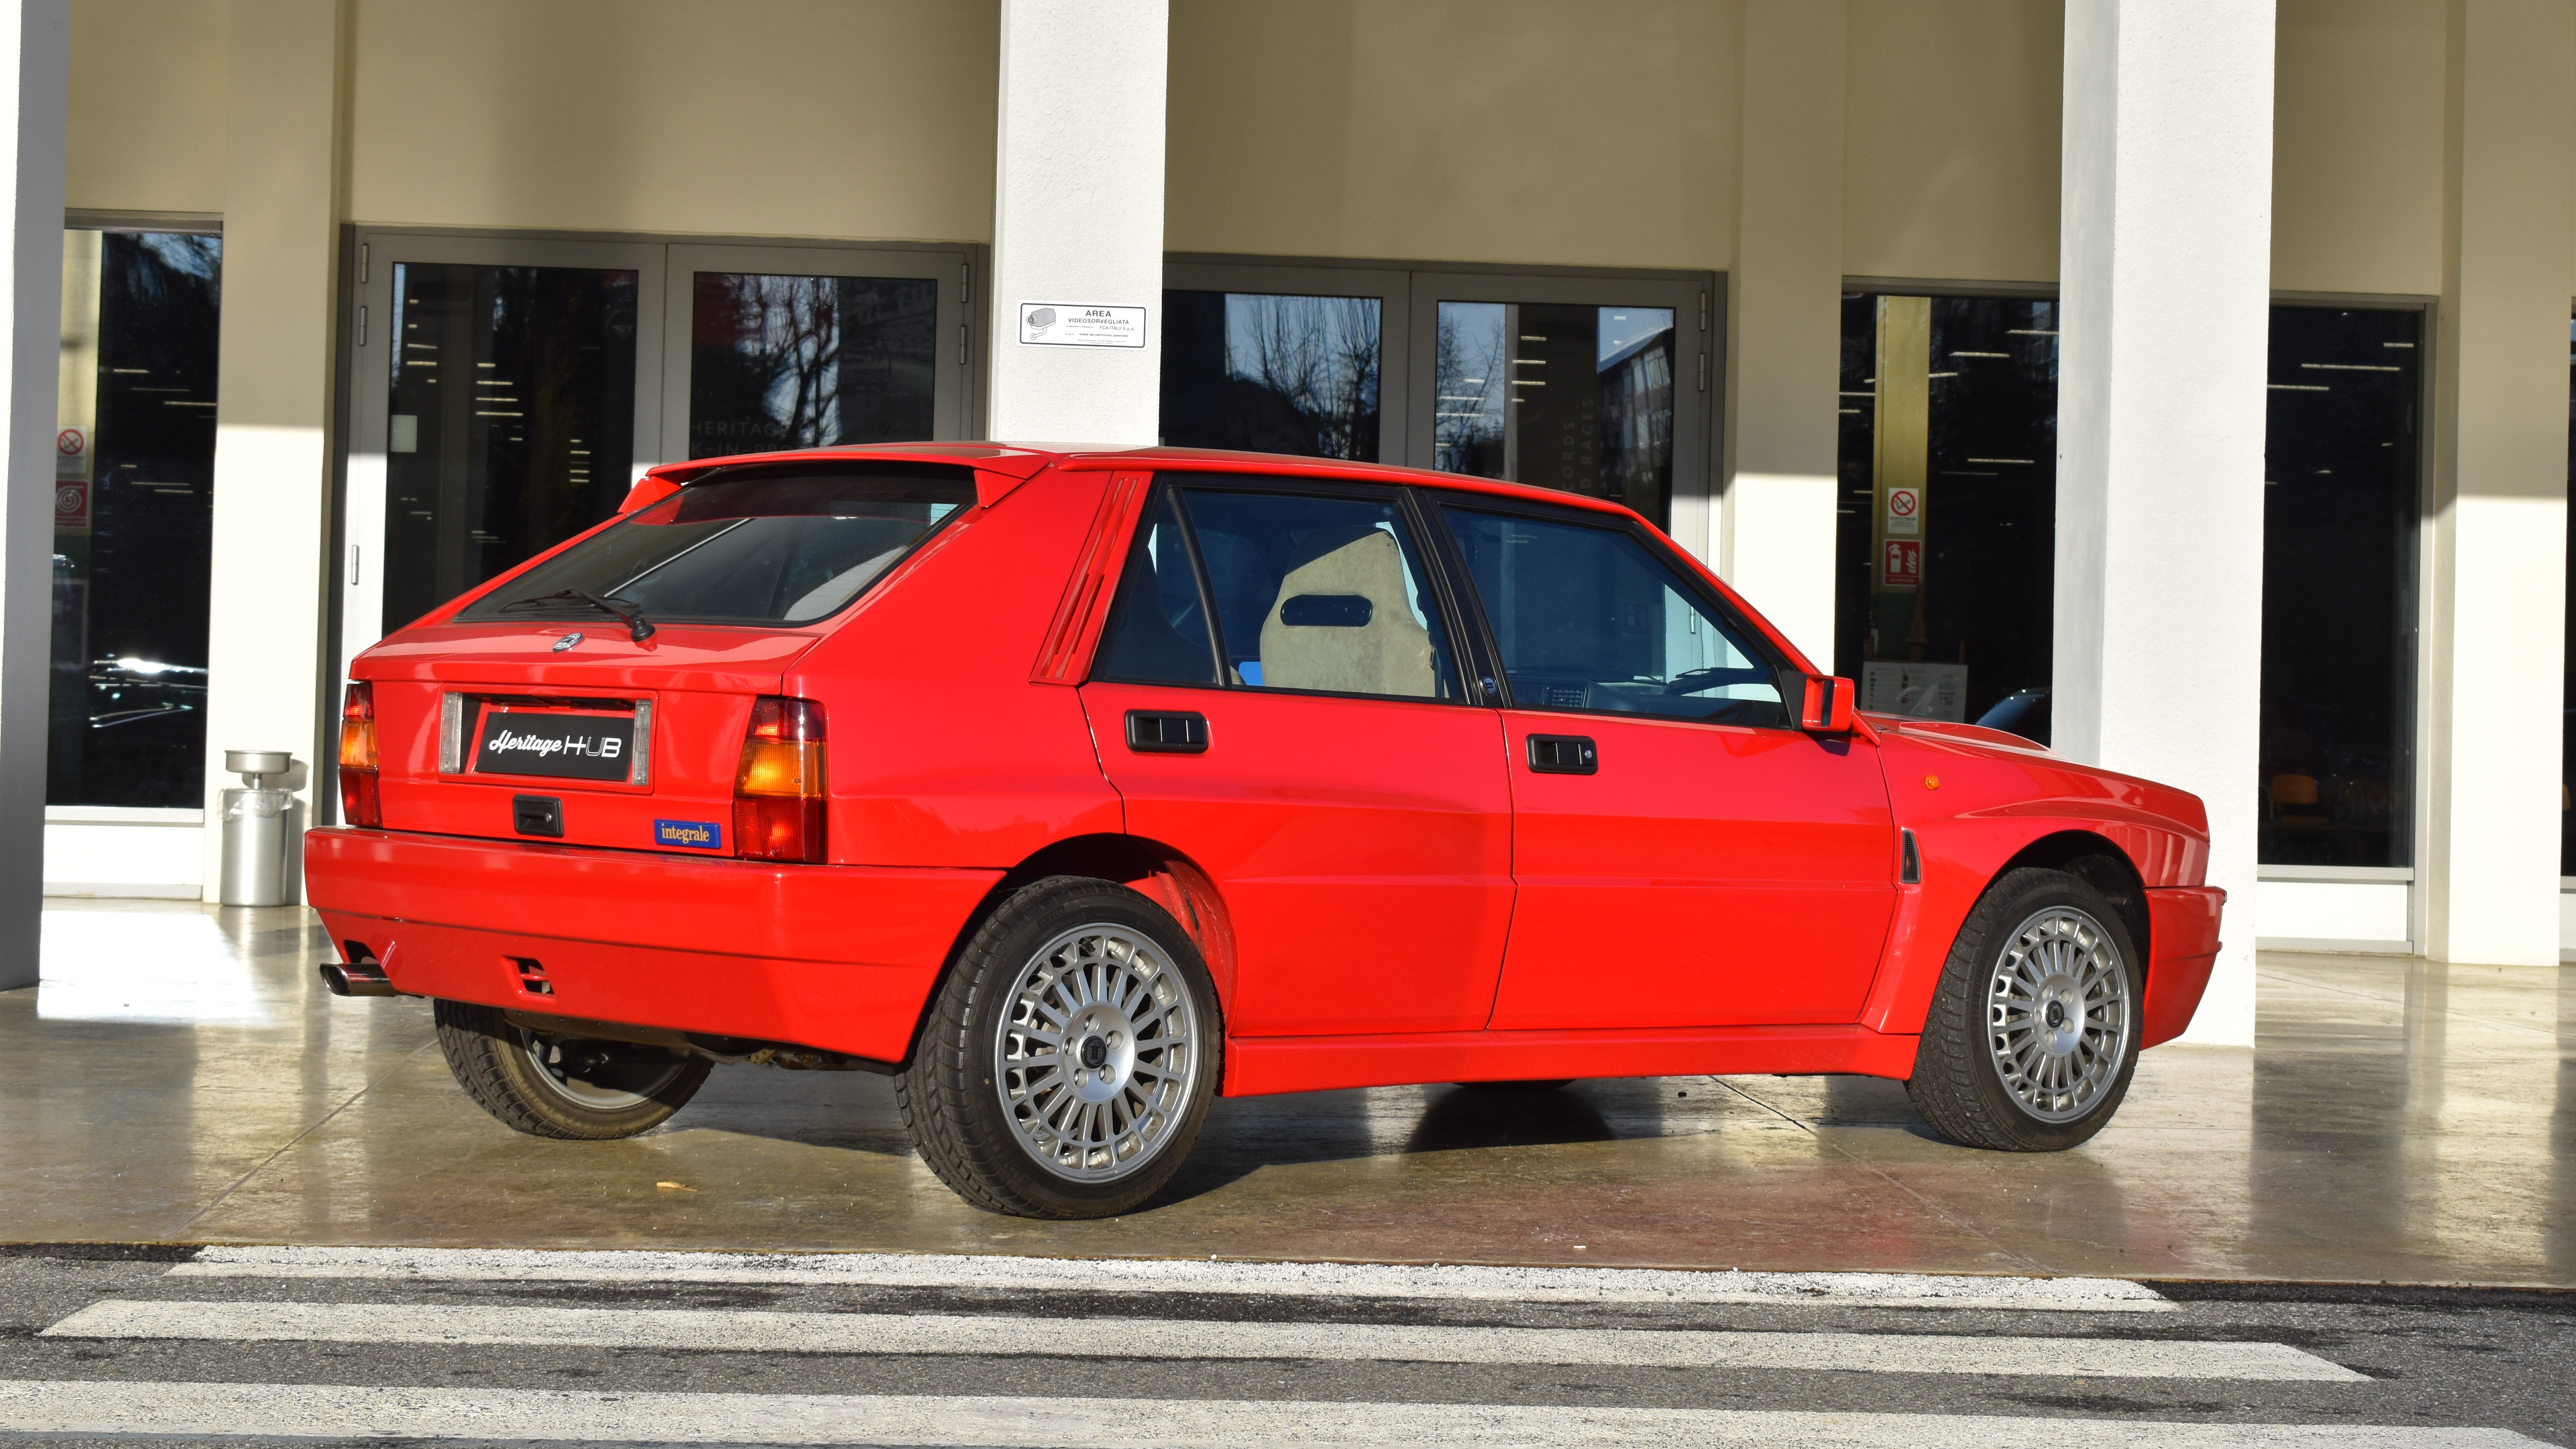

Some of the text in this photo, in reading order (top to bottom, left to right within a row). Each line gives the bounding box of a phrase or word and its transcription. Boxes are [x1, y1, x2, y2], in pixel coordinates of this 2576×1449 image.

[489, 730, 621, 758] Heritage HUB
[661, 823, 709, 844] integrale
